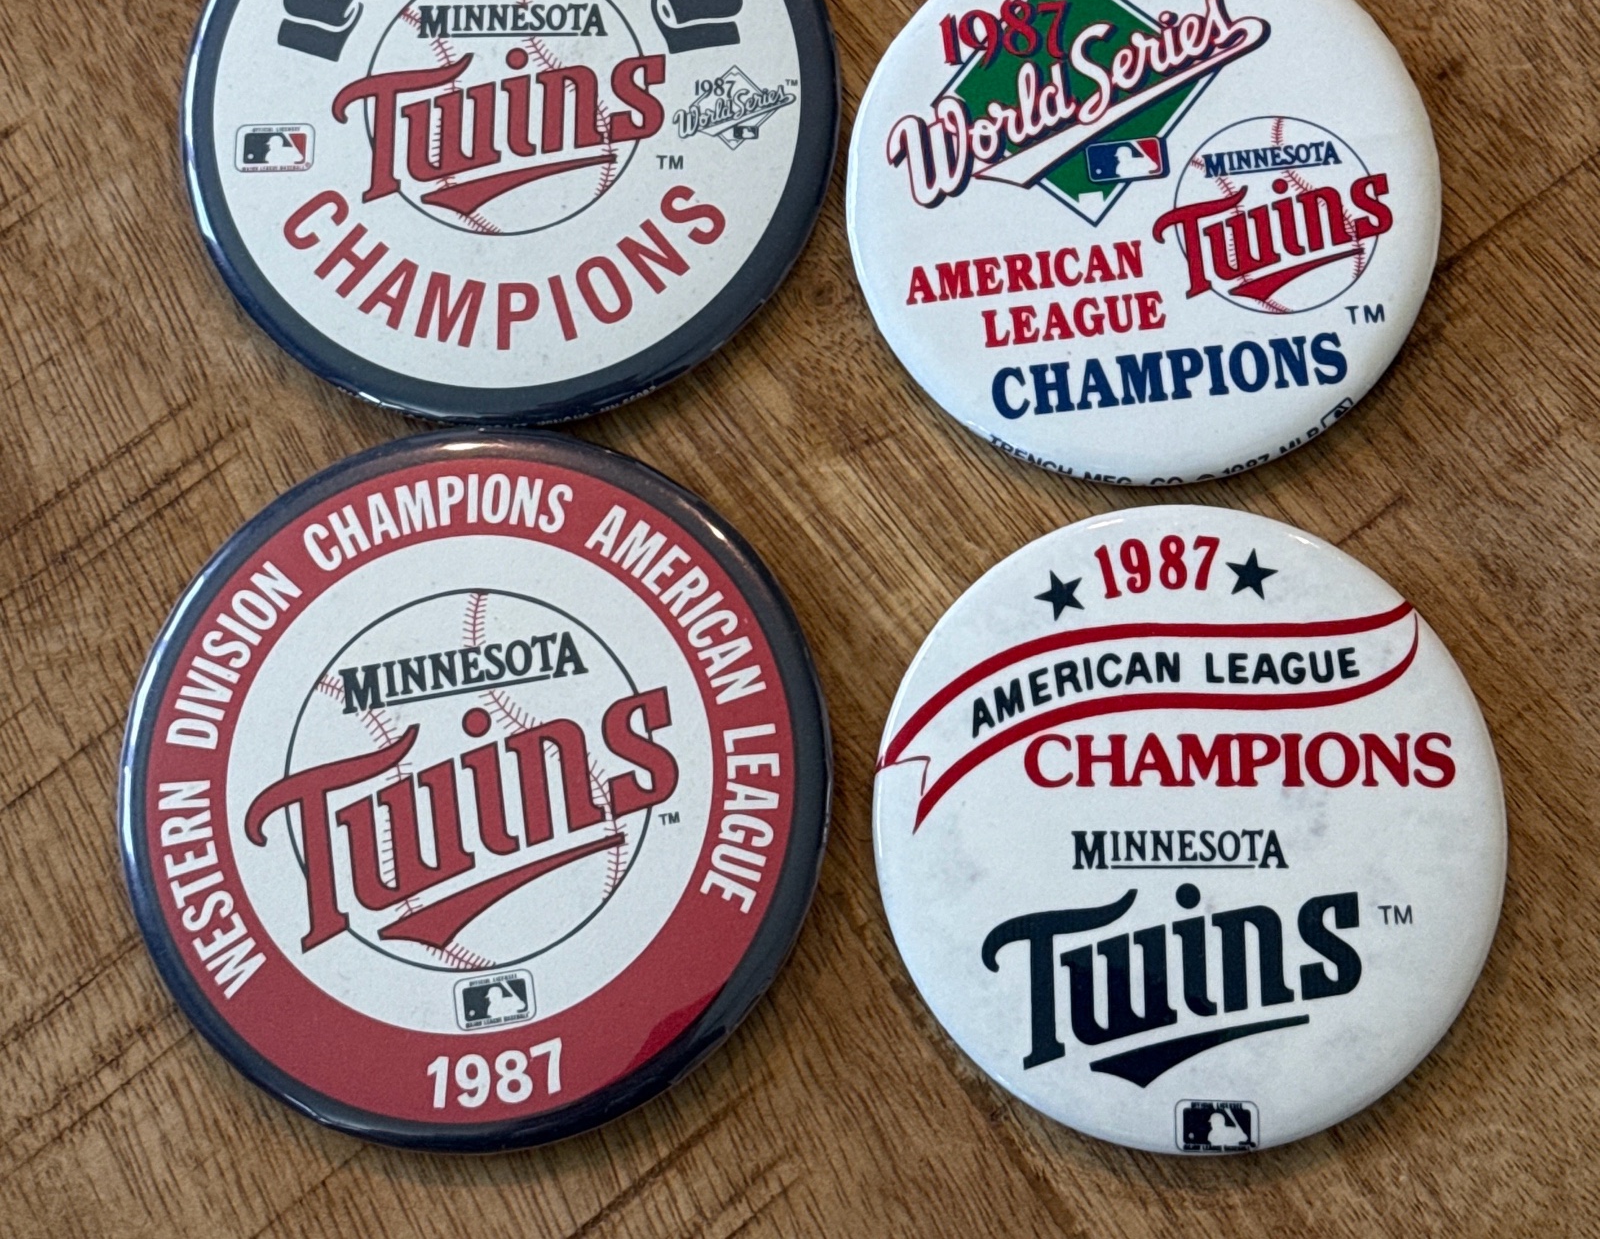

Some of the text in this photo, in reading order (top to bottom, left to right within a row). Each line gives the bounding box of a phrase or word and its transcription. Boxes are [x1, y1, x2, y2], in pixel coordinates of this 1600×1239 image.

[417, 3, 608, 39] MINNESOTA
[332, 48, 685, 204] Twins TM
[673, 97, 735, 139] World
[733, 84, 796, 120] Series
[695, 77, 736, 99] 1987
[886, 60, 1076, 208] World
[1204, 141, 1342, 179] MINNESOTA
[283, 185, 726, 350] CHAMPIONS
[906, 240, 1144, 306] AMERICAN
[1152, 173, 1393, 324] Twins TM
[982, 290, 1167, 348] LEAGUE
[991, 332, 1348, 420] CHAMPIONS
[1094, 535, 1220, 600] 1987
[341, 631, 589, 714] MINNESOTA
[970, 647, 1361, 738] AMERICAN LEAGUE
[158, 473, 781, 1000] WESTERN DIVISION CHAMPIONS AMERICAN LEAGUE
[1023, 732, 1457, 789] CHAMPIONS
[244, 686, 681, 952] Twins TM
[1071, 830, 1289, 871] MINNESOTA
[981, 882, 1413, 1071] Twins TM
[426, 1037, 563, 1109] 1987
